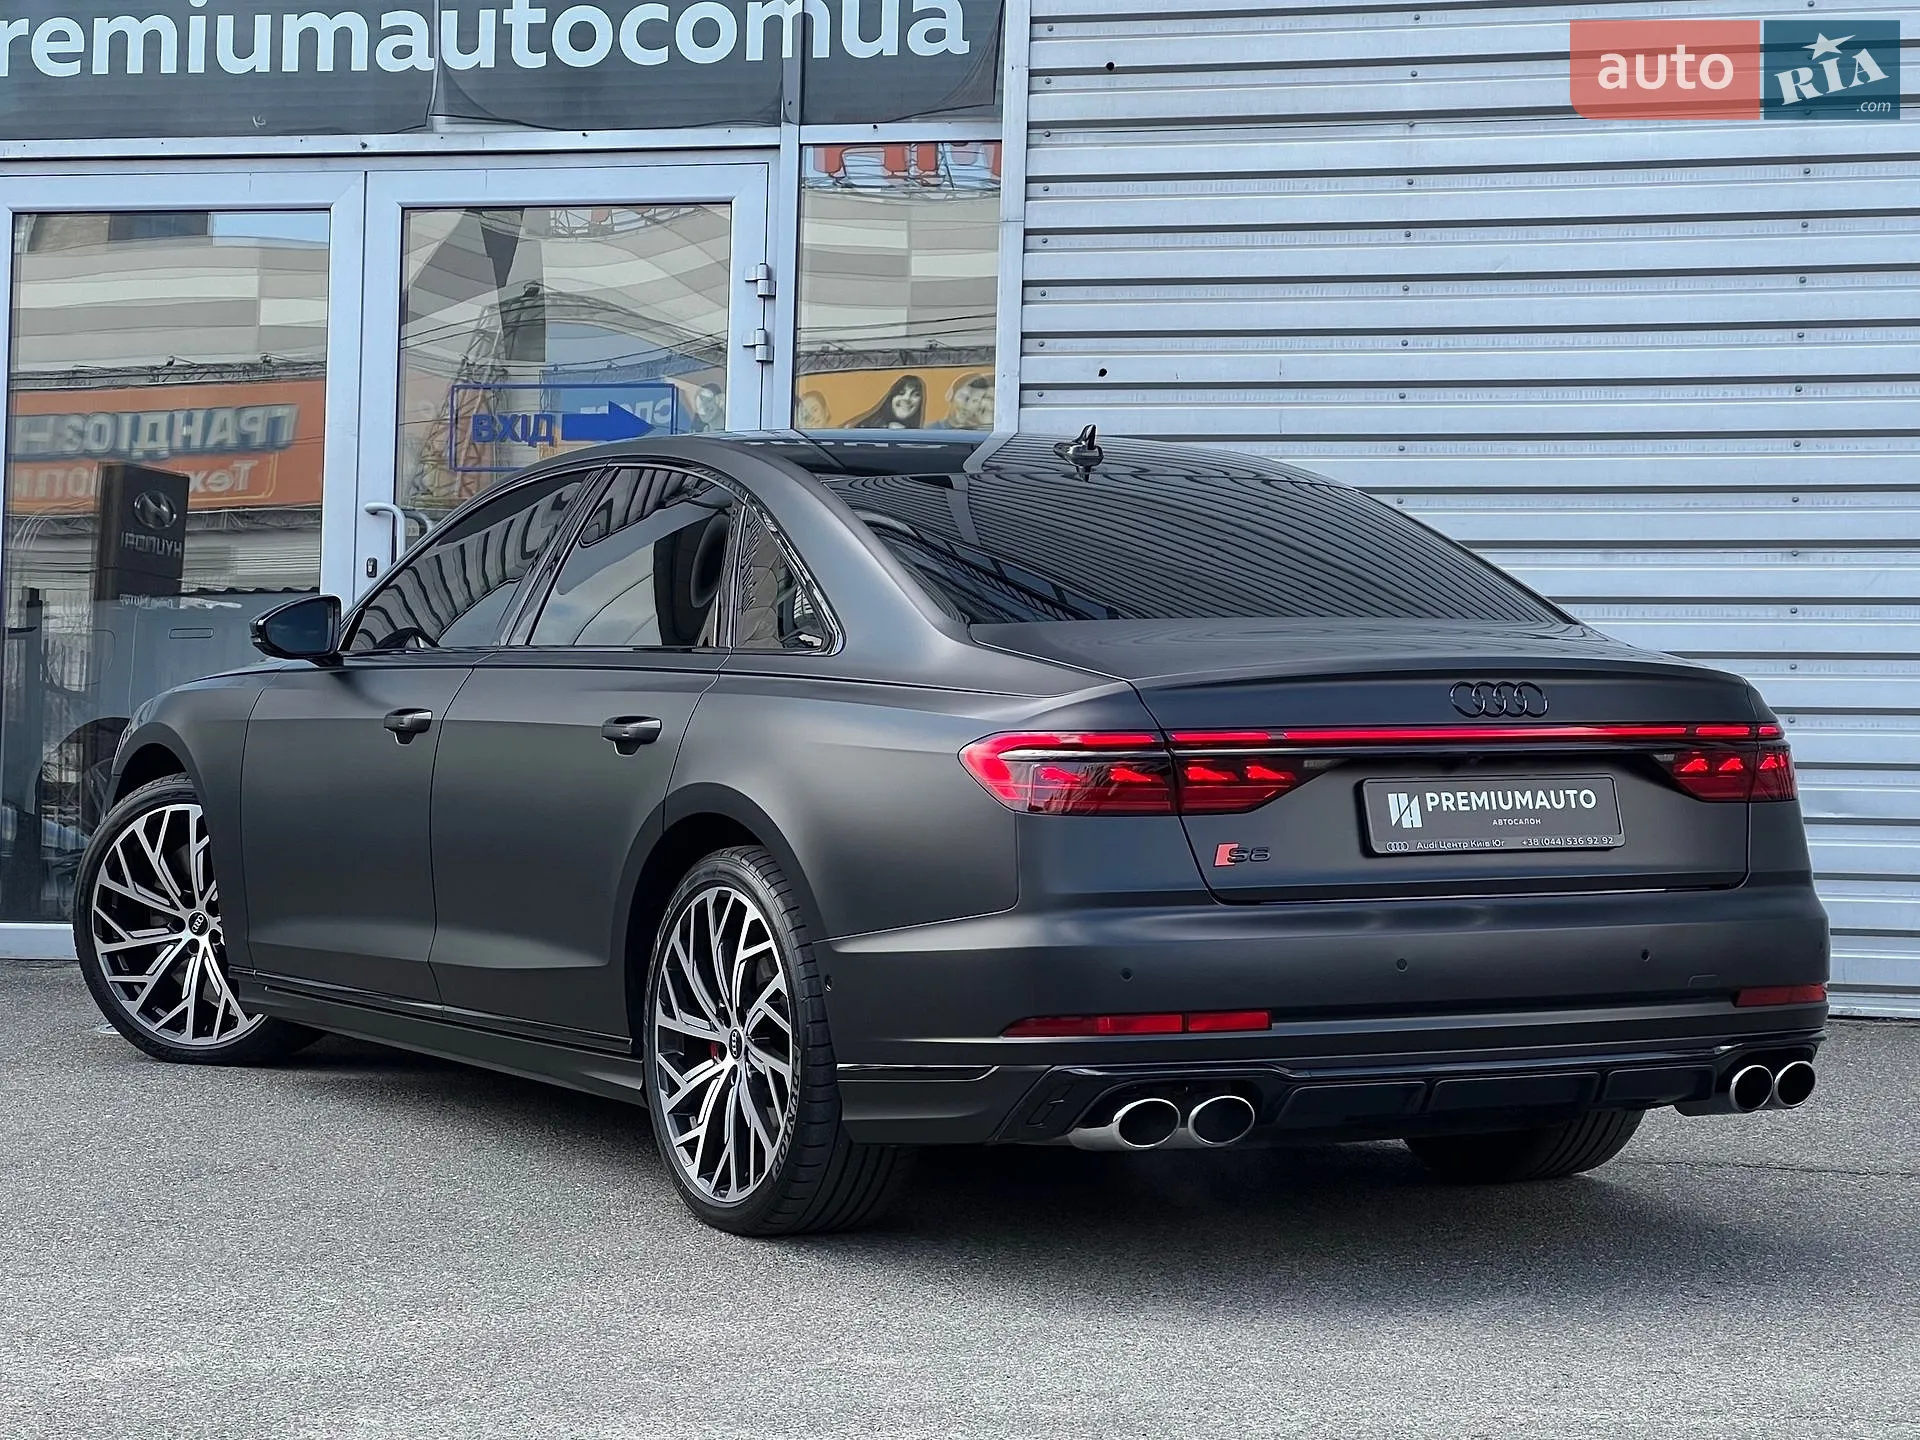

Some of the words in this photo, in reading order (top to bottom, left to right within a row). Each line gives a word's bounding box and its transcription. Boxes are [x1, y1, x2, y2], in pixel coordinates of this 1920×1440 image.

[472, 413, 555, 448] ВХІД
[1425, 789, 1597, 812] PREMIUMAUTO
[1492, 818, 1542, 827] АВТОСАЛОН
[1416, 841, 1438, 849] Audi
